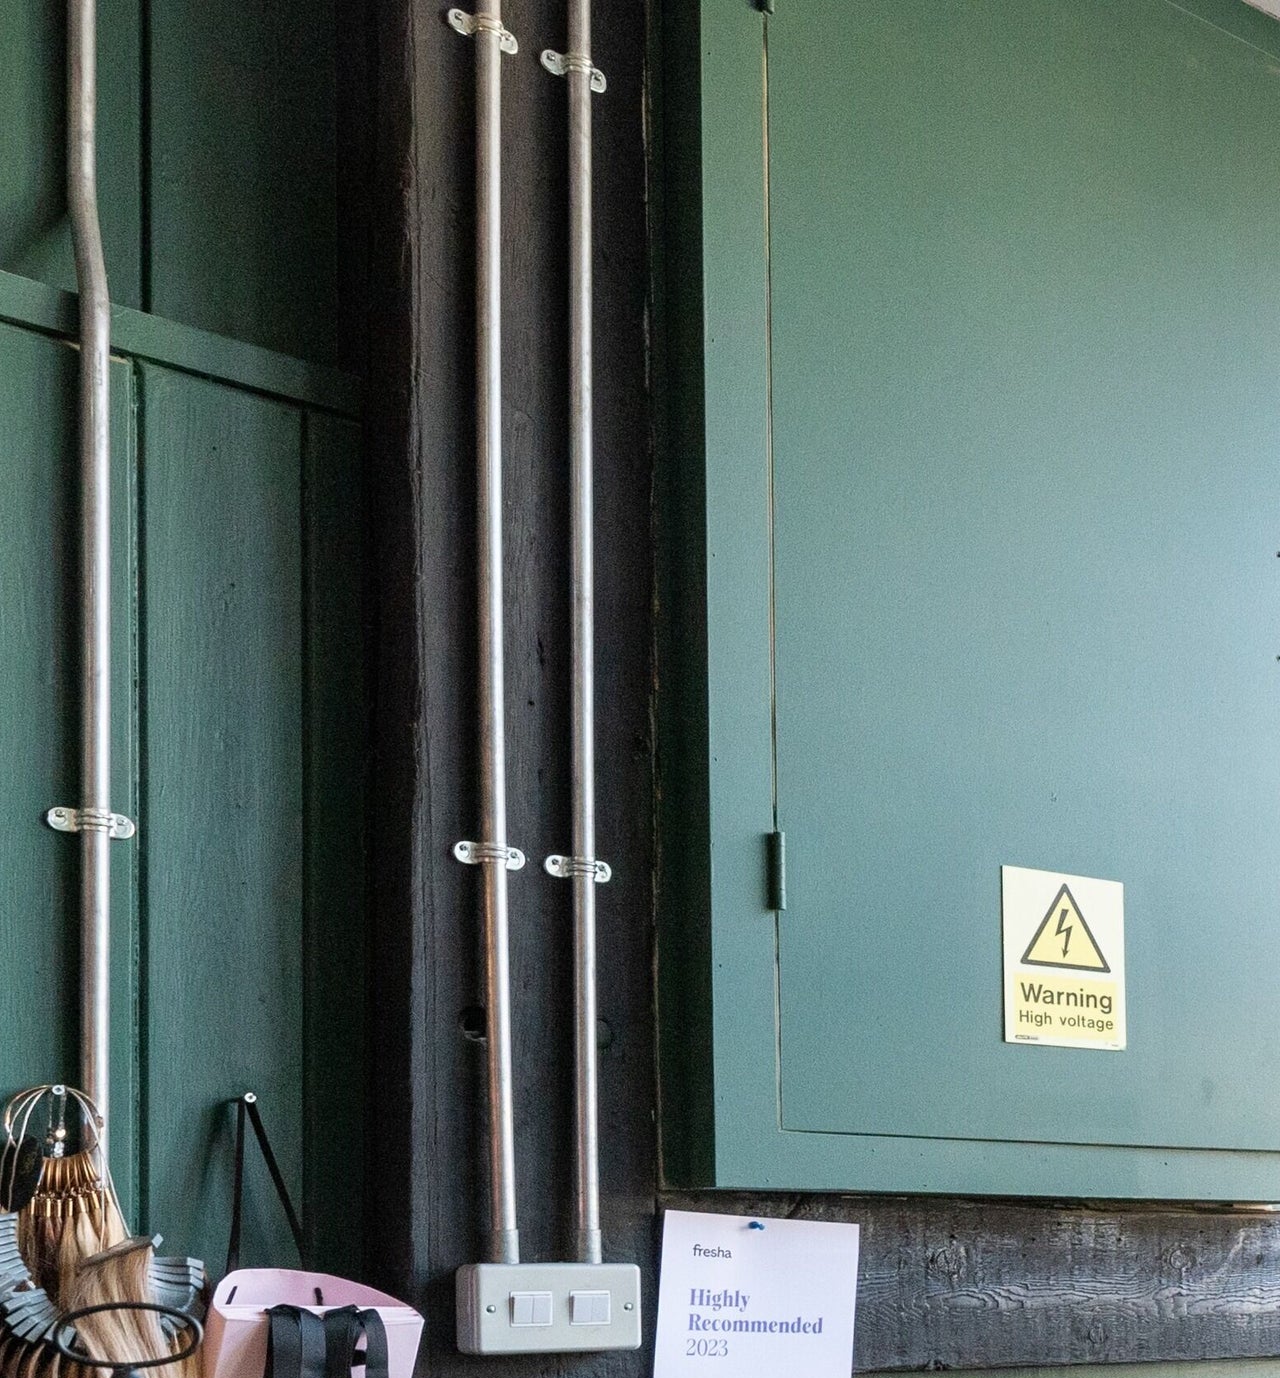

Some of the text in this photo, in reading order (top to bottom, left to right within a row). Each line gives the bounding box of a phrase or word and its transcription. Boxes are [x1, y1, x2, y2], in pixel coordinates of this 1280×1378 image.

[1020, 982, 1112, 1014] Warning
[1019, 1010, 1113, 1032] High voltage
[692, 1244, 732, 1259] fresha
[690, 1288, 751, 1312] Highly
[688, 1313, 823, 1335] Recommended
[686, 1338, 729, 1357] 2023
